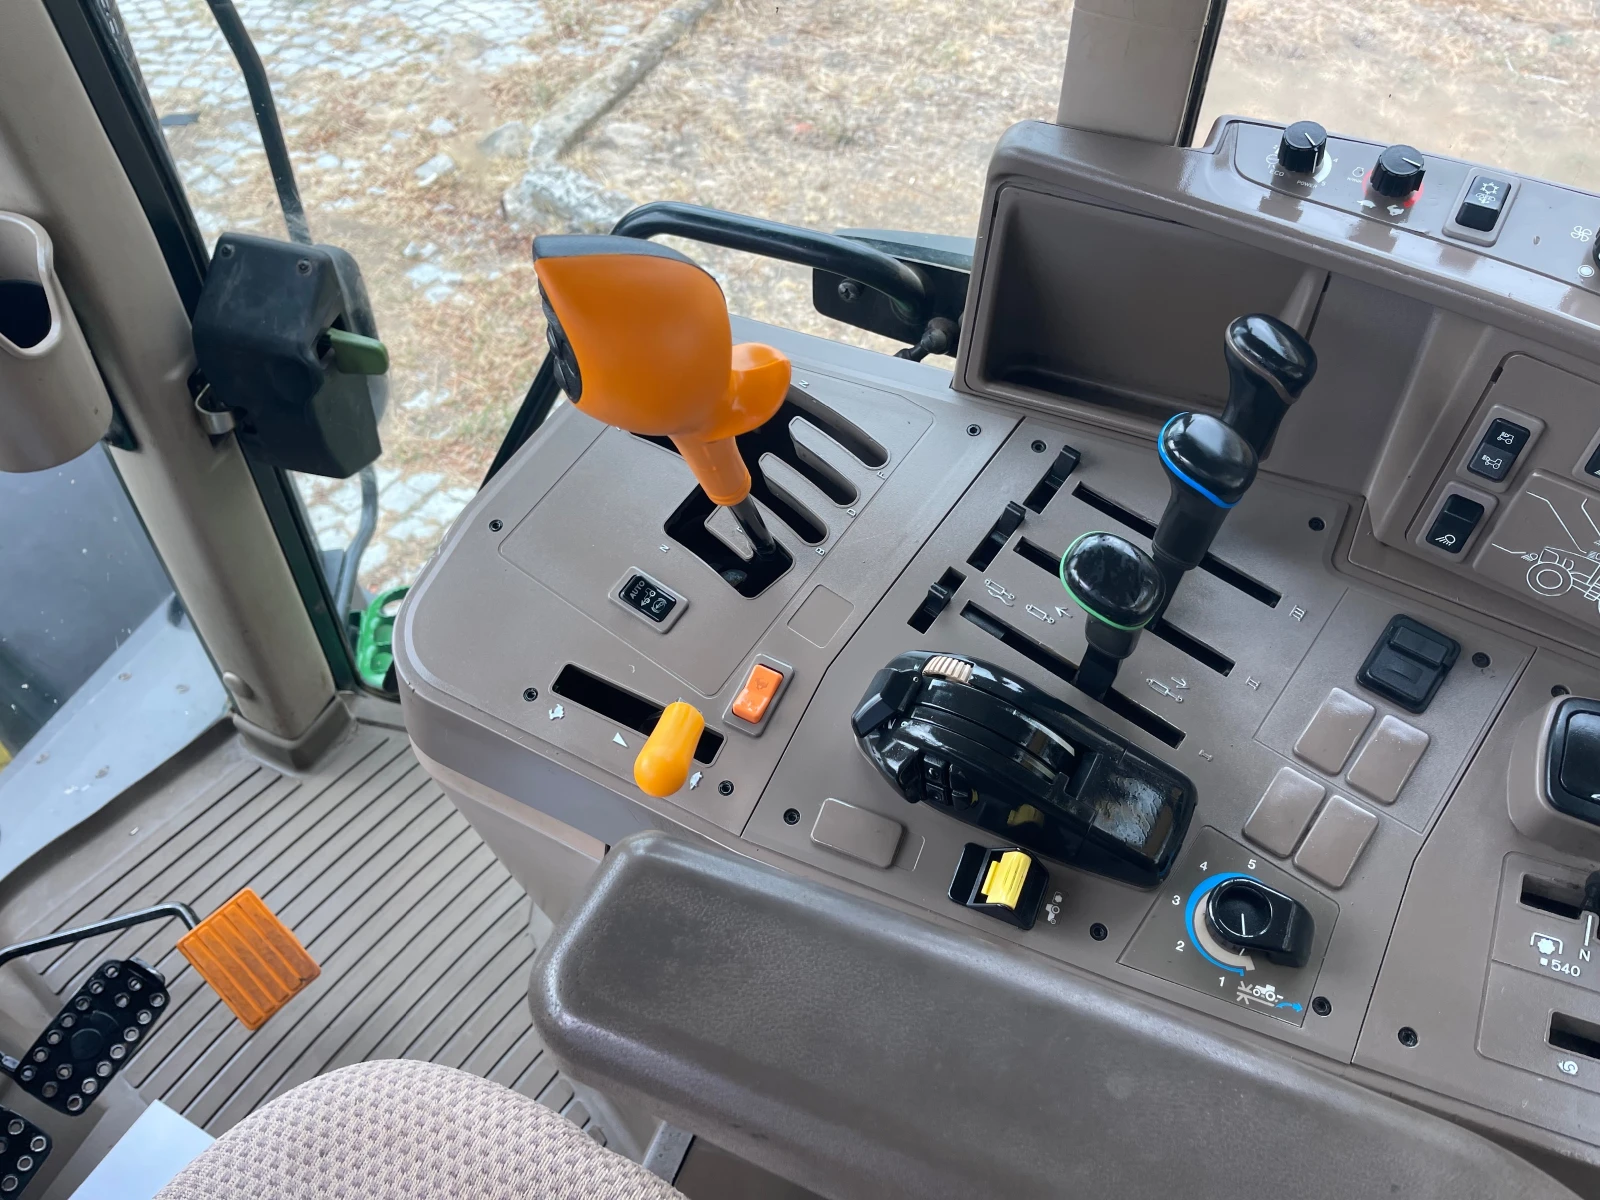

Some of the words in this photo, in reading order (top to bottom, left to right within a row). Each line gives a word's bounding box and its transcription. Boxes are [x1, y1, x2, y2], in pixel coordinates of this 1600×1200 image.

[1268, 169, 1285, 177] ECO
[1296, 179, 1318, 189] POWER
[876, 471, 886, 480] F
[846, 508, 857, 517] D
[815, 547, 825, 556] B
[629, 580, 645, 600] AUTO
[1199, 861, 1208, 871] 4
[1247, 859, 1257, 870] 5
[1171, 895, 1181, 906] 3
[1175, 940, 1185, 952] 2
[1578, 948, 1591, 962] N
[1550, 958, 1581, 977] 540
[1218, 976, 1225, 987] 1
